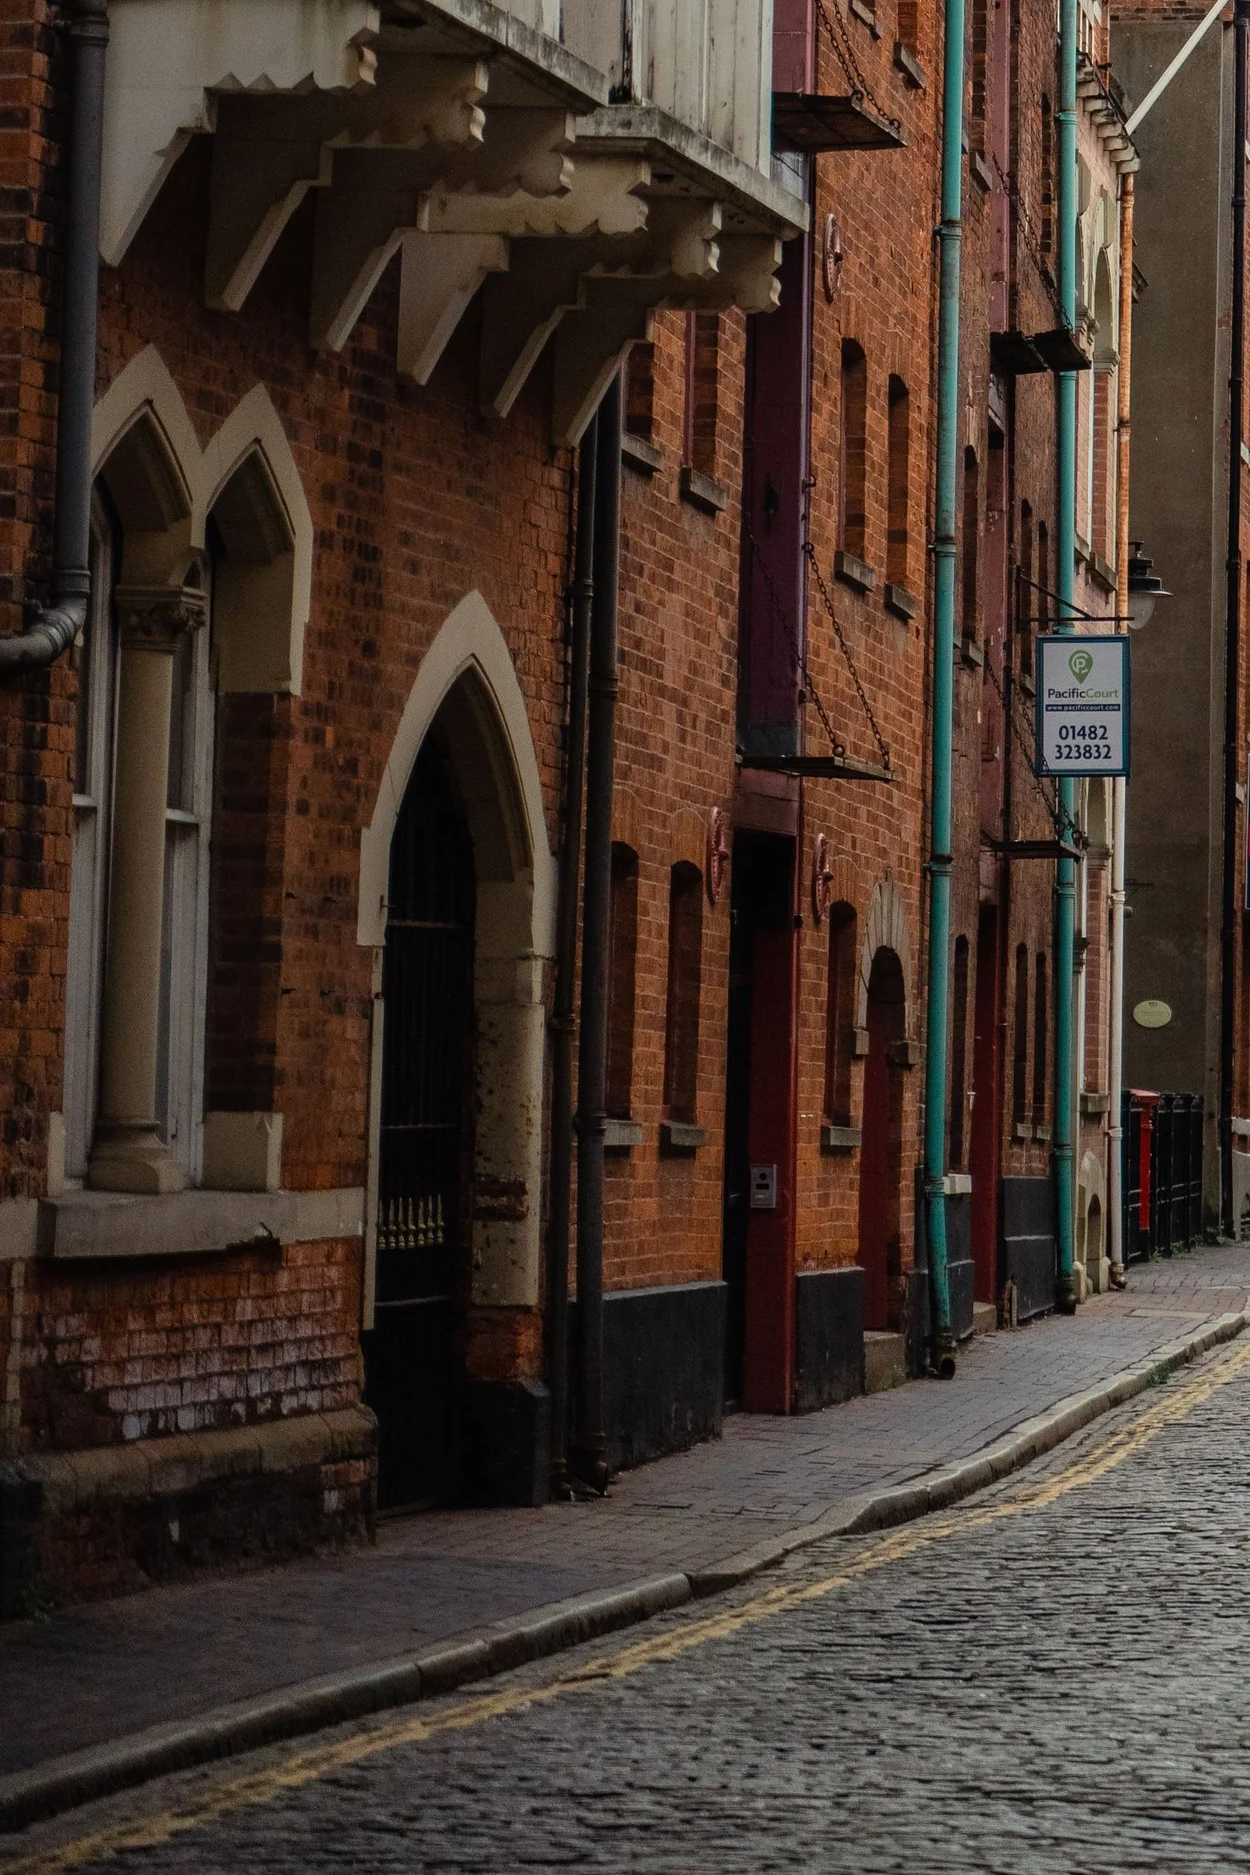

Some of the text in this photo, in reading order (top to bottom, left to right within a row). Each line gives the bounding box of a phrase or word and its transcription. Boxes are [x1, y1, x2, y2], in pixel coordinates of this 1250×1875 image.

[1048, 688, 1119, 699] PacificCourt
[1059, 725, 1109, 740] 01482
[1055, 744, 1112, 760] 323832
